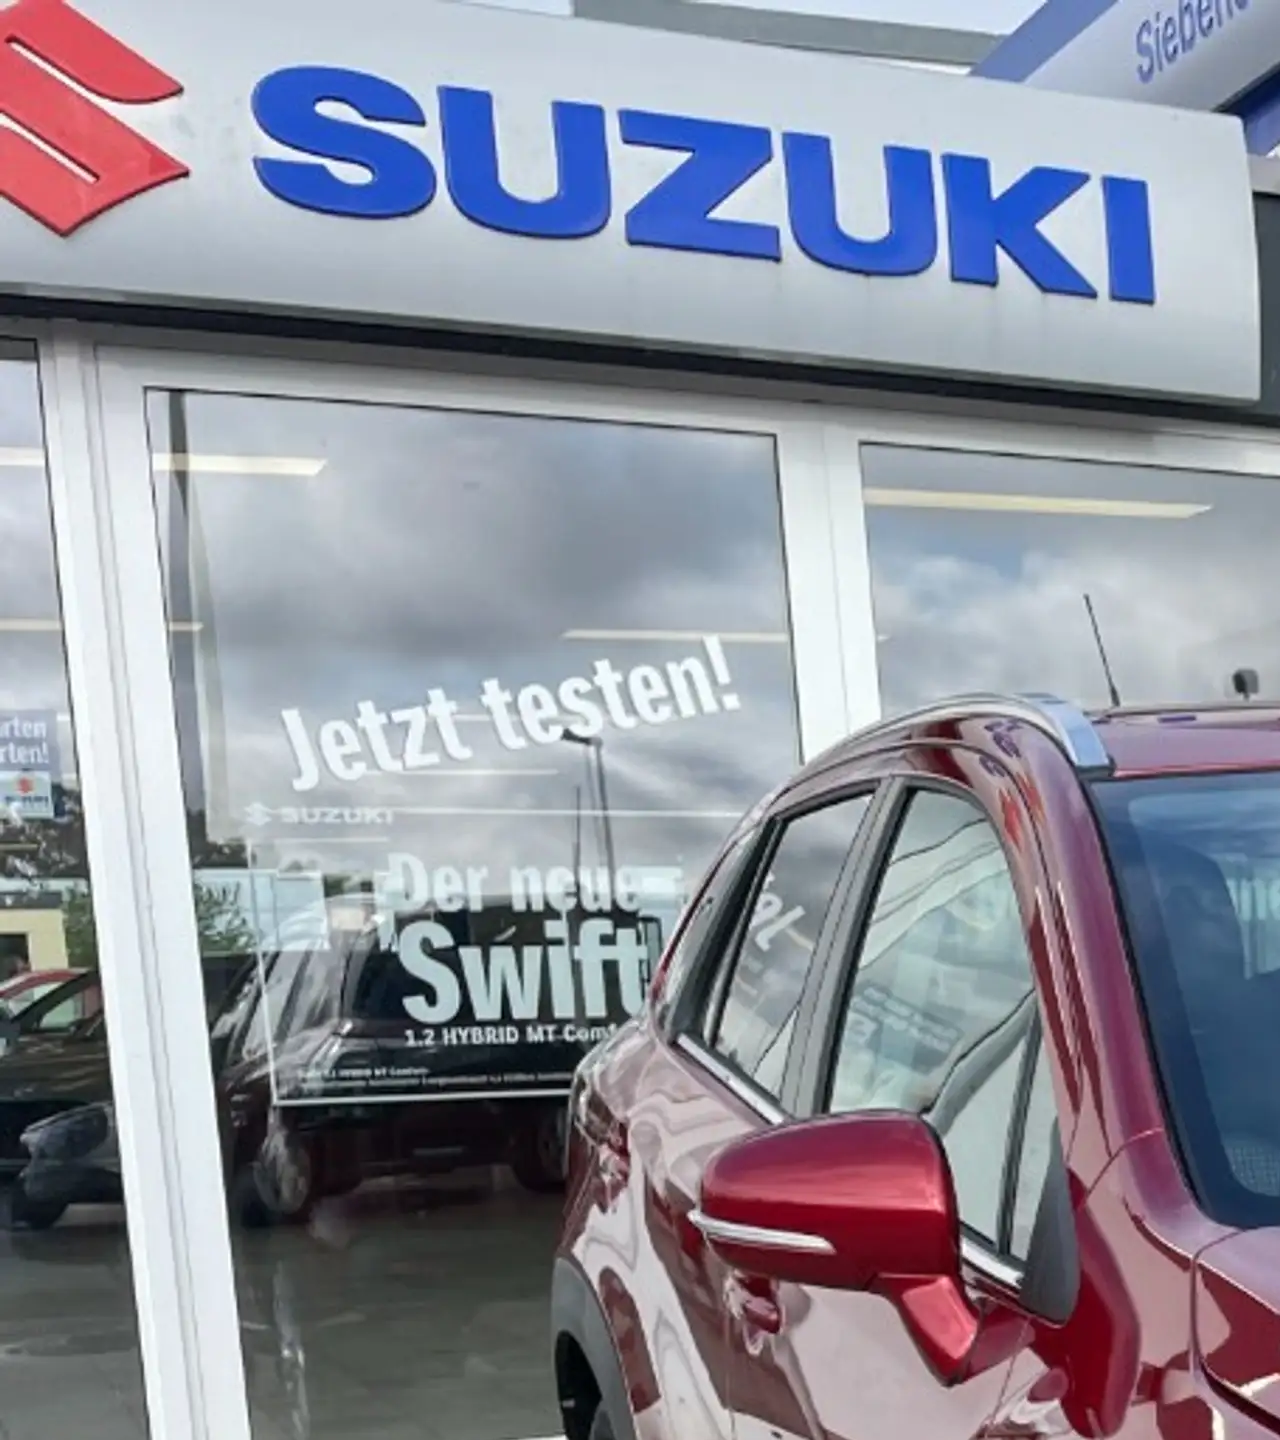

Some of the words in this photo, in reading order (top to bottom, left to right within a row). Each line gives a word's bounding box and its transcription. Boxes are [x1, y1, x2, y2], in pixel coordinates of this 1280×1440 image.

[251, 65, 1156, 305] SUZUKI
[281, 688, 473, 791] Jetzt
[480, 634, 741, 750] testen!
[279, 804, 395, 827] SUZUKI
[387, 852, 489, 913] Der
[510, 863, 641, 914] neue
[399, 908, 648, 1026] Swift
[404, 1028, 436, 1048] 1.2
[442, 1025, 519, 1048] HYBRID
[526, 1024, 557, 1043] MT
